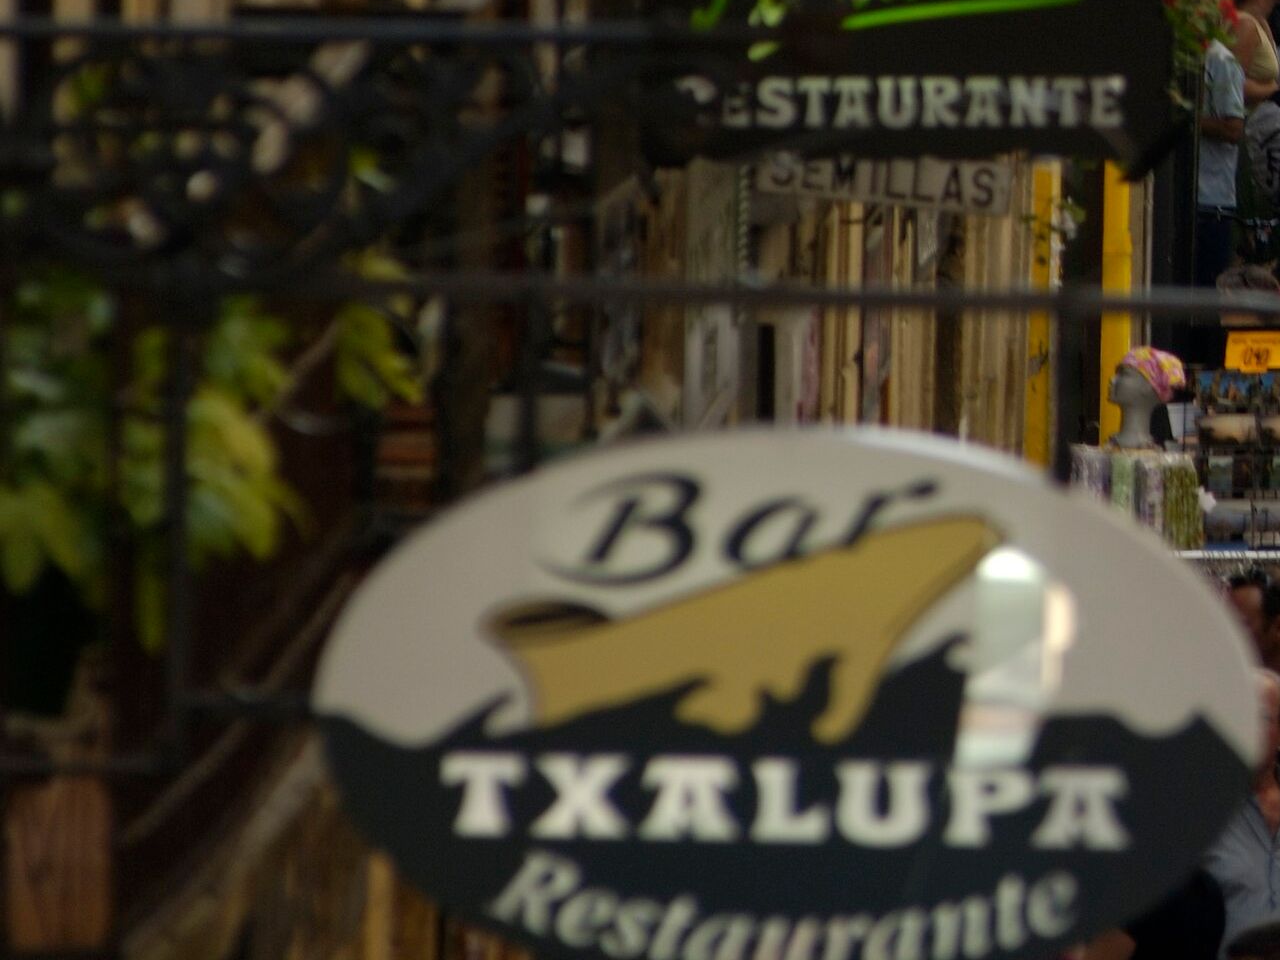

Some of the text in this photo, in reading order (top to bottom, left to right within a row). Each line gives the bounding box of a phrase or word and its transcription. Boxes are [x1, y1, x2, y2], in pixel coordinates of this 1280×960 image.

[769, 151, 995, 208] SEMILLAS
[533, 470, 943, 586] Bar
[440, 751, 1130, 854] TXALUPA
[488, 849, 1080, 960] Restaurante
